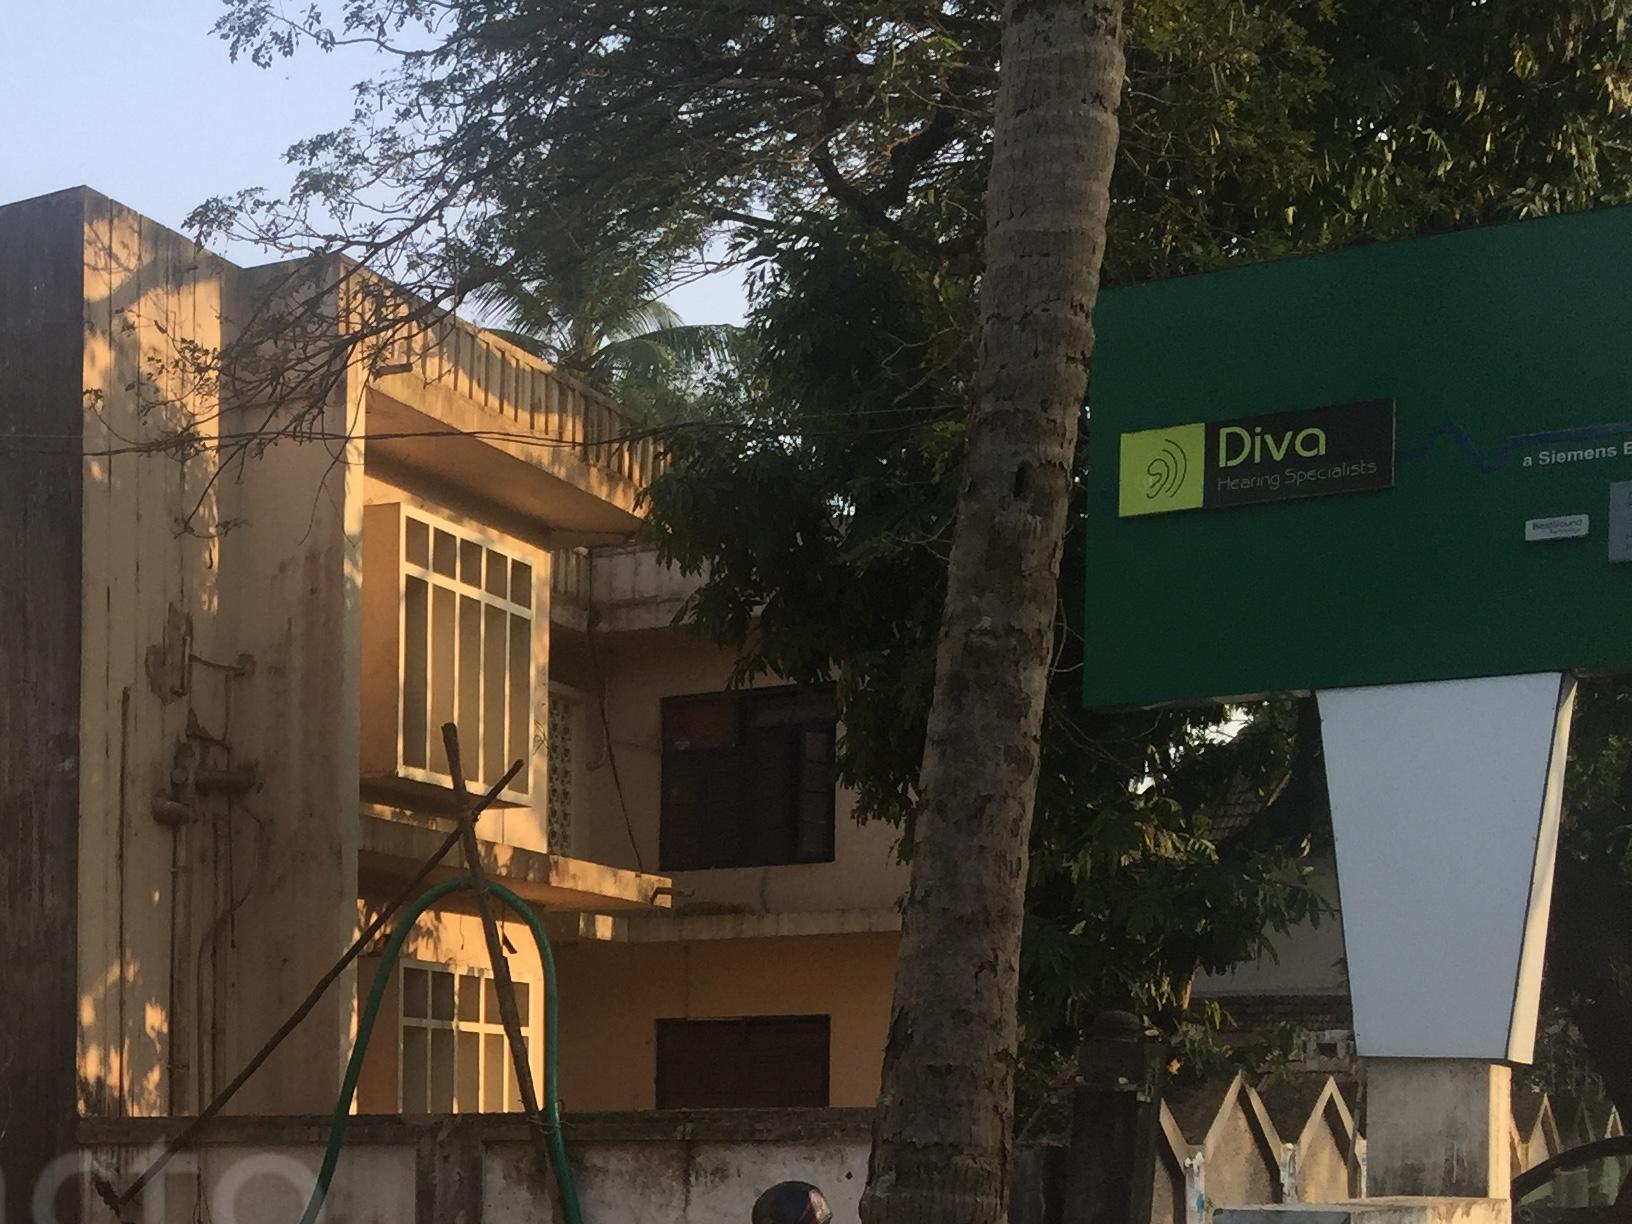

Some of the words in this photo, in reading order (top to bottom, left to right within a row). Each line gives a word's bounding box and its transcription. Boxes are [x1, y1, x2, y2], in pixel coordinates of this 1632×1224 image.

[1219, 426, 1326, 468] Diva
[1522, 456, 1533, 467] a
[1538, 446, 1617, 465] Siemens
[1218, 473, 1280, 490] Hearing
[1285, 460, 1377, 486] Specialists
